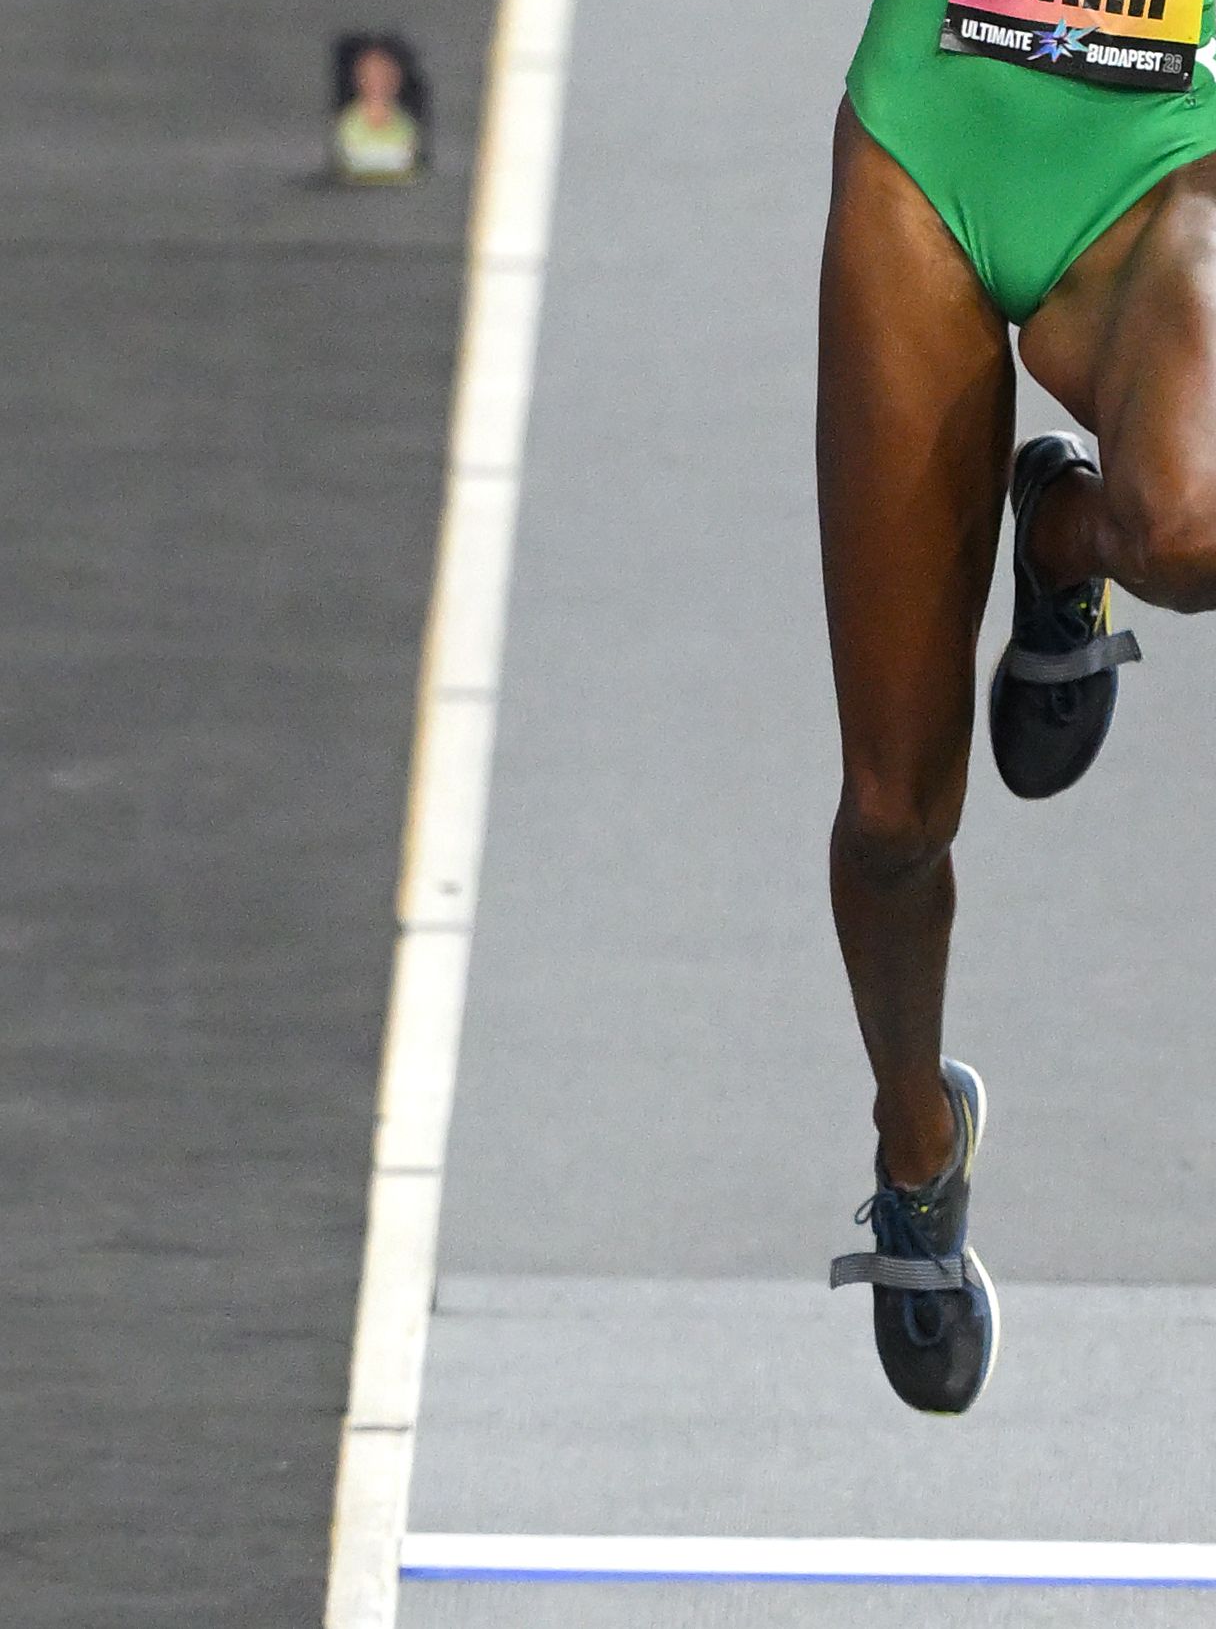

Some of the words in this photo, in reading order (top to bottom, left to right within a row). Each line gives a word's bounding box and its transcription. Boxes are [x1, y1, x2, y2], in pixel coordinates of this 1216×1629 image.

[961, 18, 1033, 51] ULTIMATE
[1086, 43, 1163, 71] BUDAPEST
[1163, 53, 1182, 74] 26
